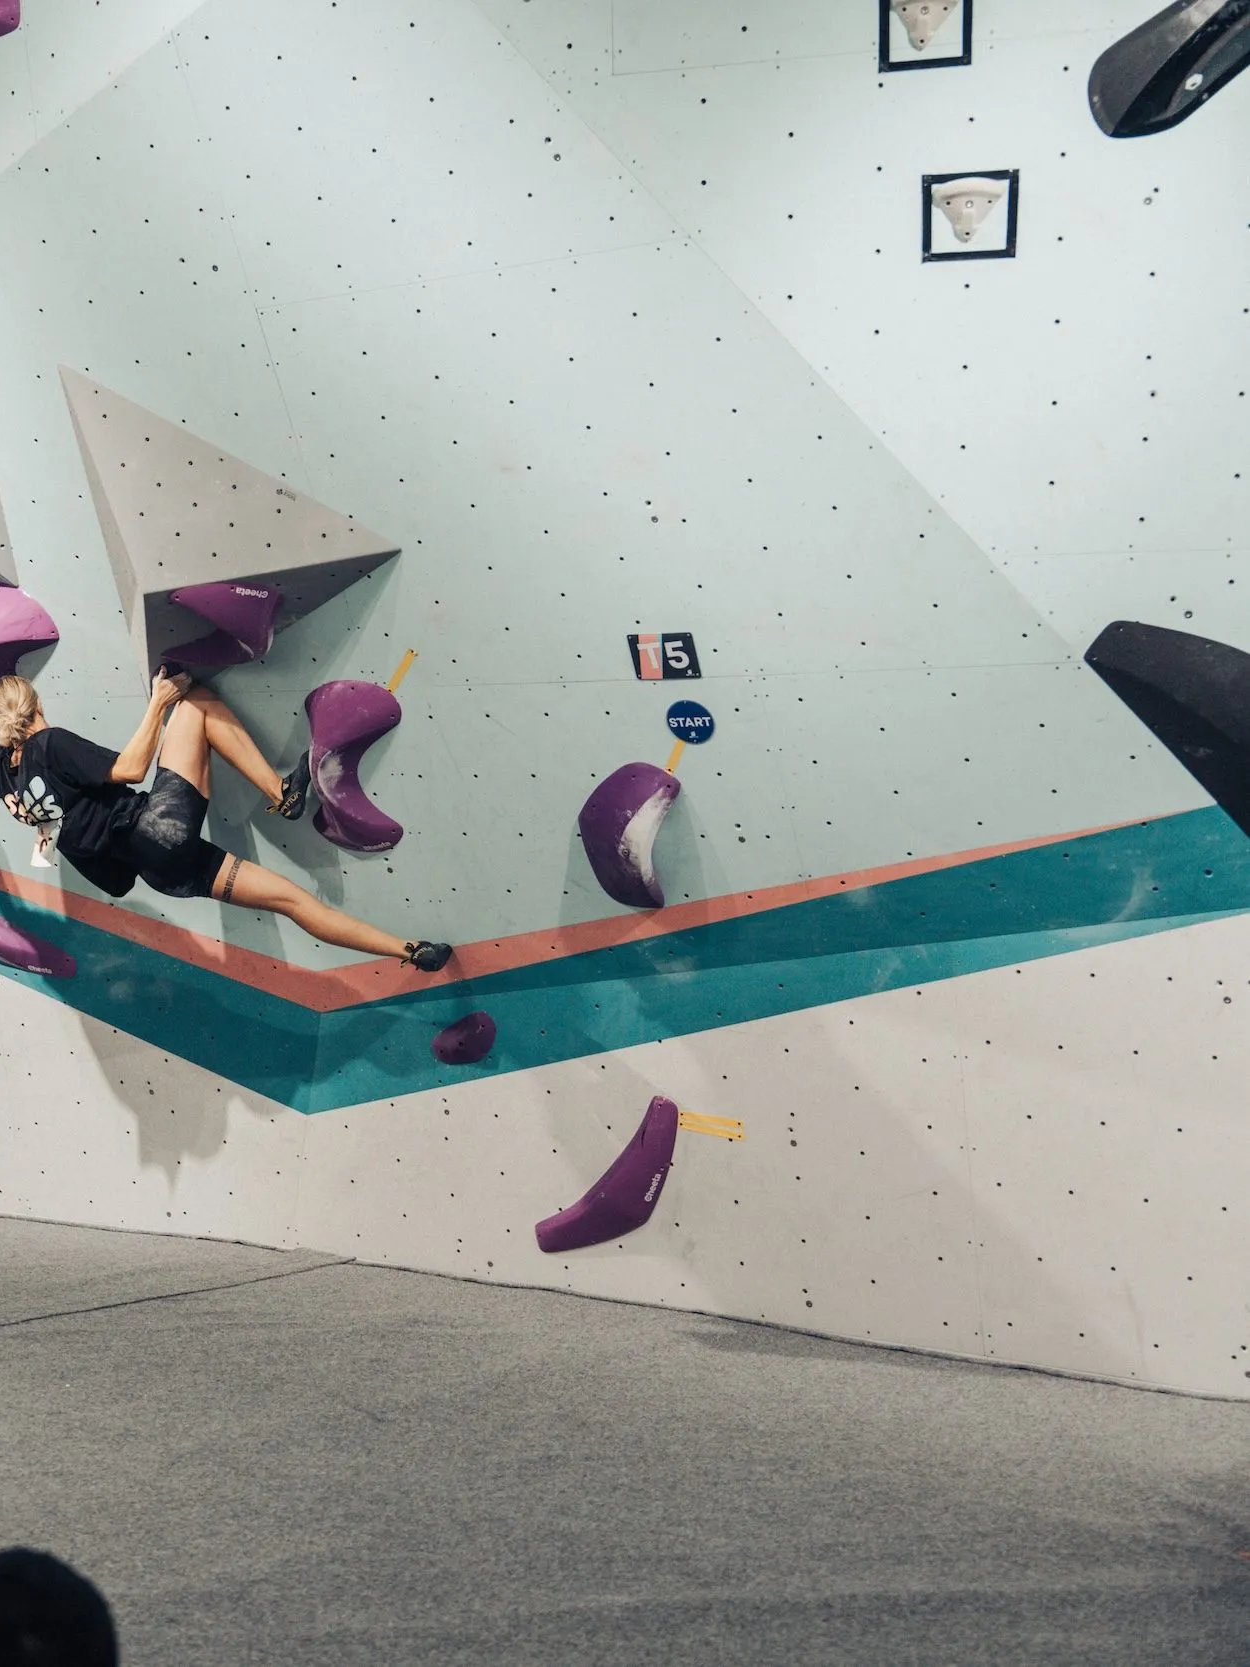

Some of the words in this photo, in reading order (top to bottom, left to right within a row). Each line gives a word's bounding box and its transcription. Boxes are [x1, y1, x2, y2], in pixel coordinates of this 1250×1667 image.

[235, 587, 269, 599] Cheeta
[637, 640, 690, 669] T5
[668, 717, 711, 728] START
[644, 1173, 661, 1202] Cheeta
